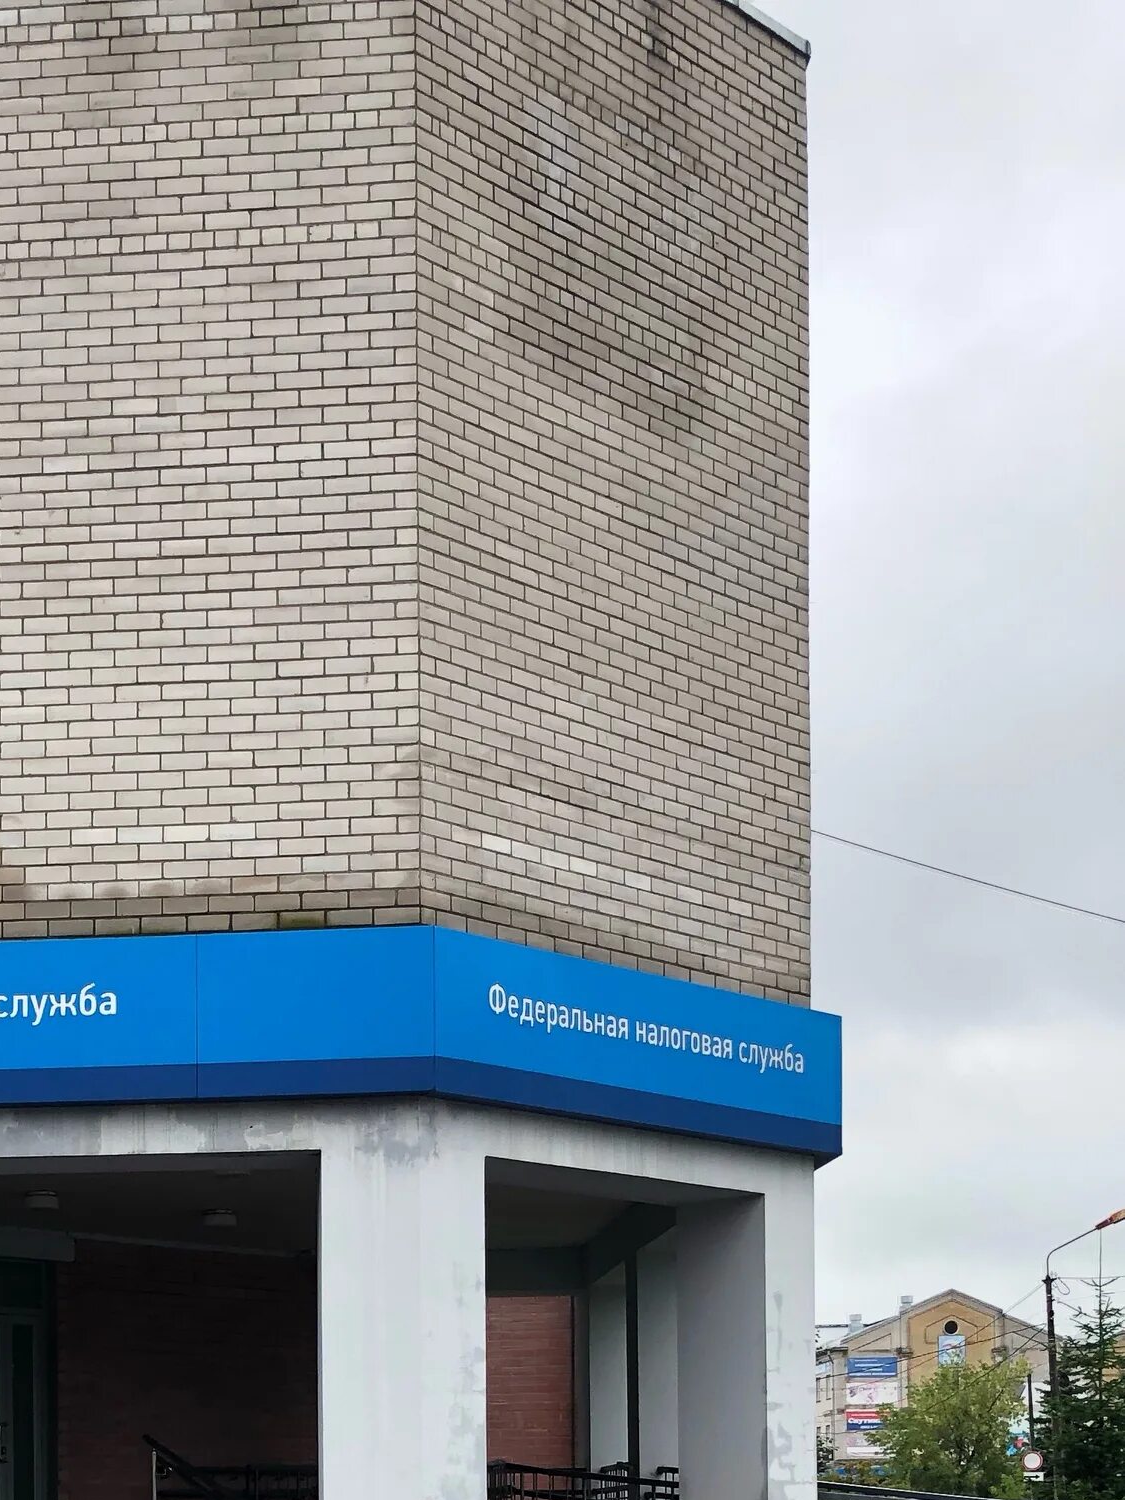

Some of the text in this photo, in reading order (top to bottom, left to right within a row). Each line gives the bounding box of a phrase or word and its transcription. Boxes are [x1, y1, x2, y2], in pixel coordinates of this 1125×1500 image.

[488, 983, 804, 1074] Федеральная налоговая служба
